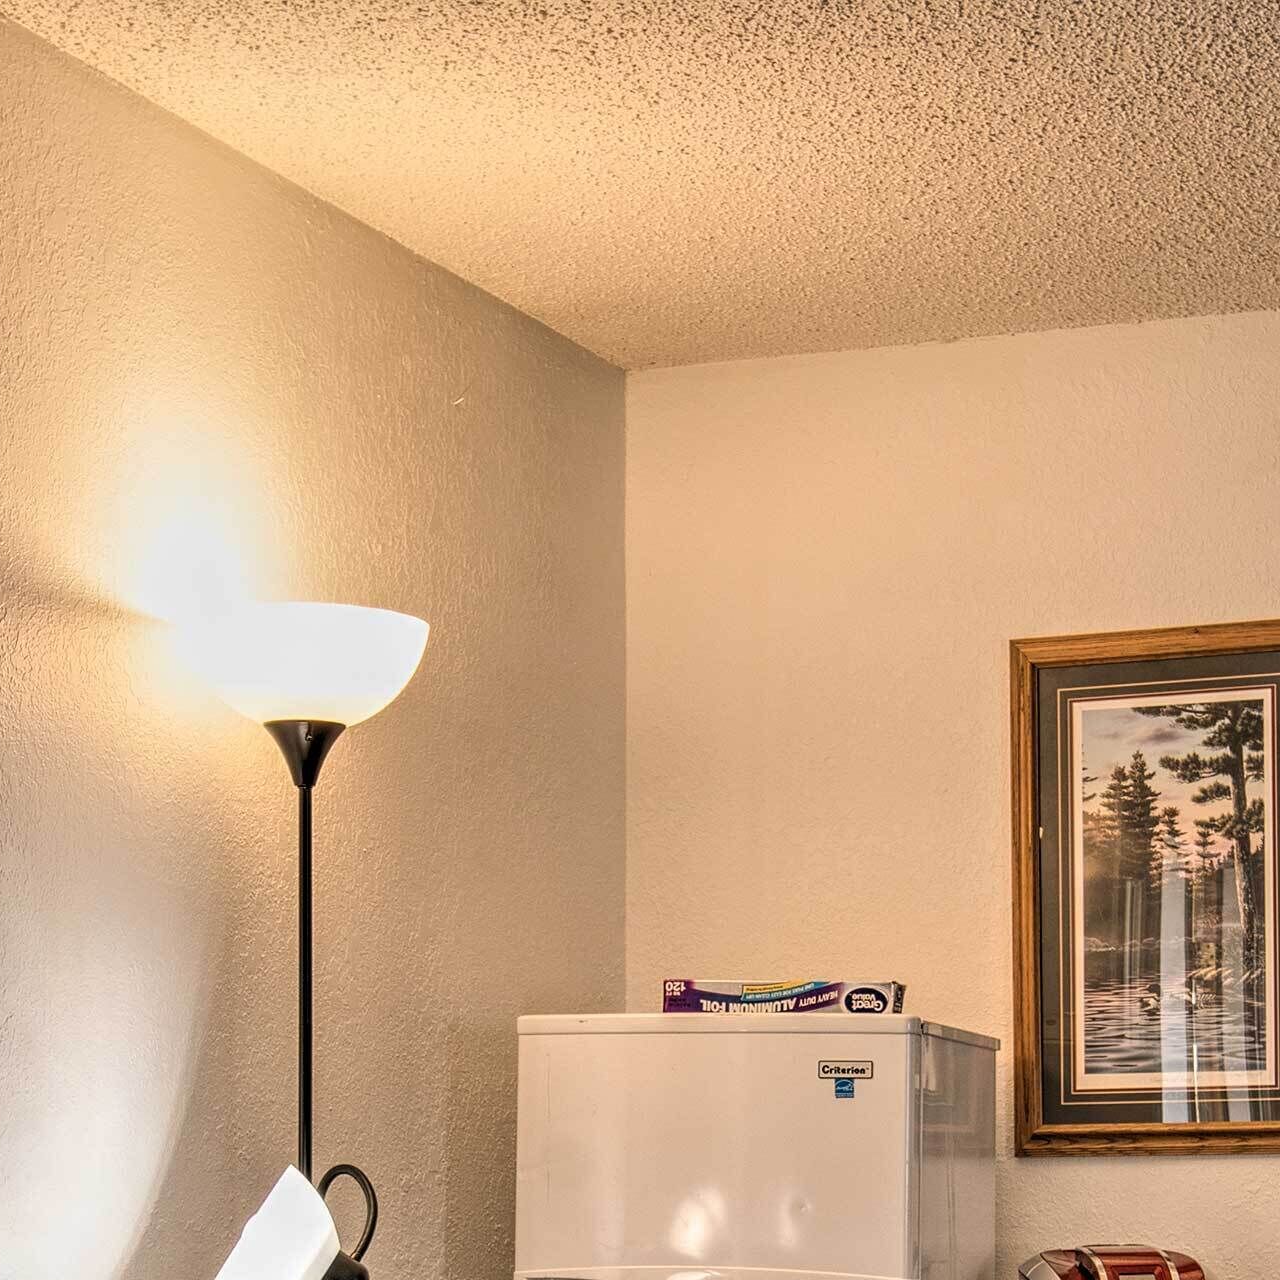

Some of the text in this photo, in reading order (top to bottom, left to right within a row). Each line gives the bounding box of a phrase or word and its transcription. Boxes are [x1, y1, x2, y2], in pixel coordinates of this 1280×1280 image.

[666, 981, 687, 991] 120
[798, 990, 838, 1007] HEAVY DUTY
[851, 993, 877, 1002] Value
[700, 999, 727, 1013] FOIL
[728, 997, 798, 1013] ALUMINUM
[851, 999, 883, 1012] Great
[821, 1064, 867, 1075] Criterion
